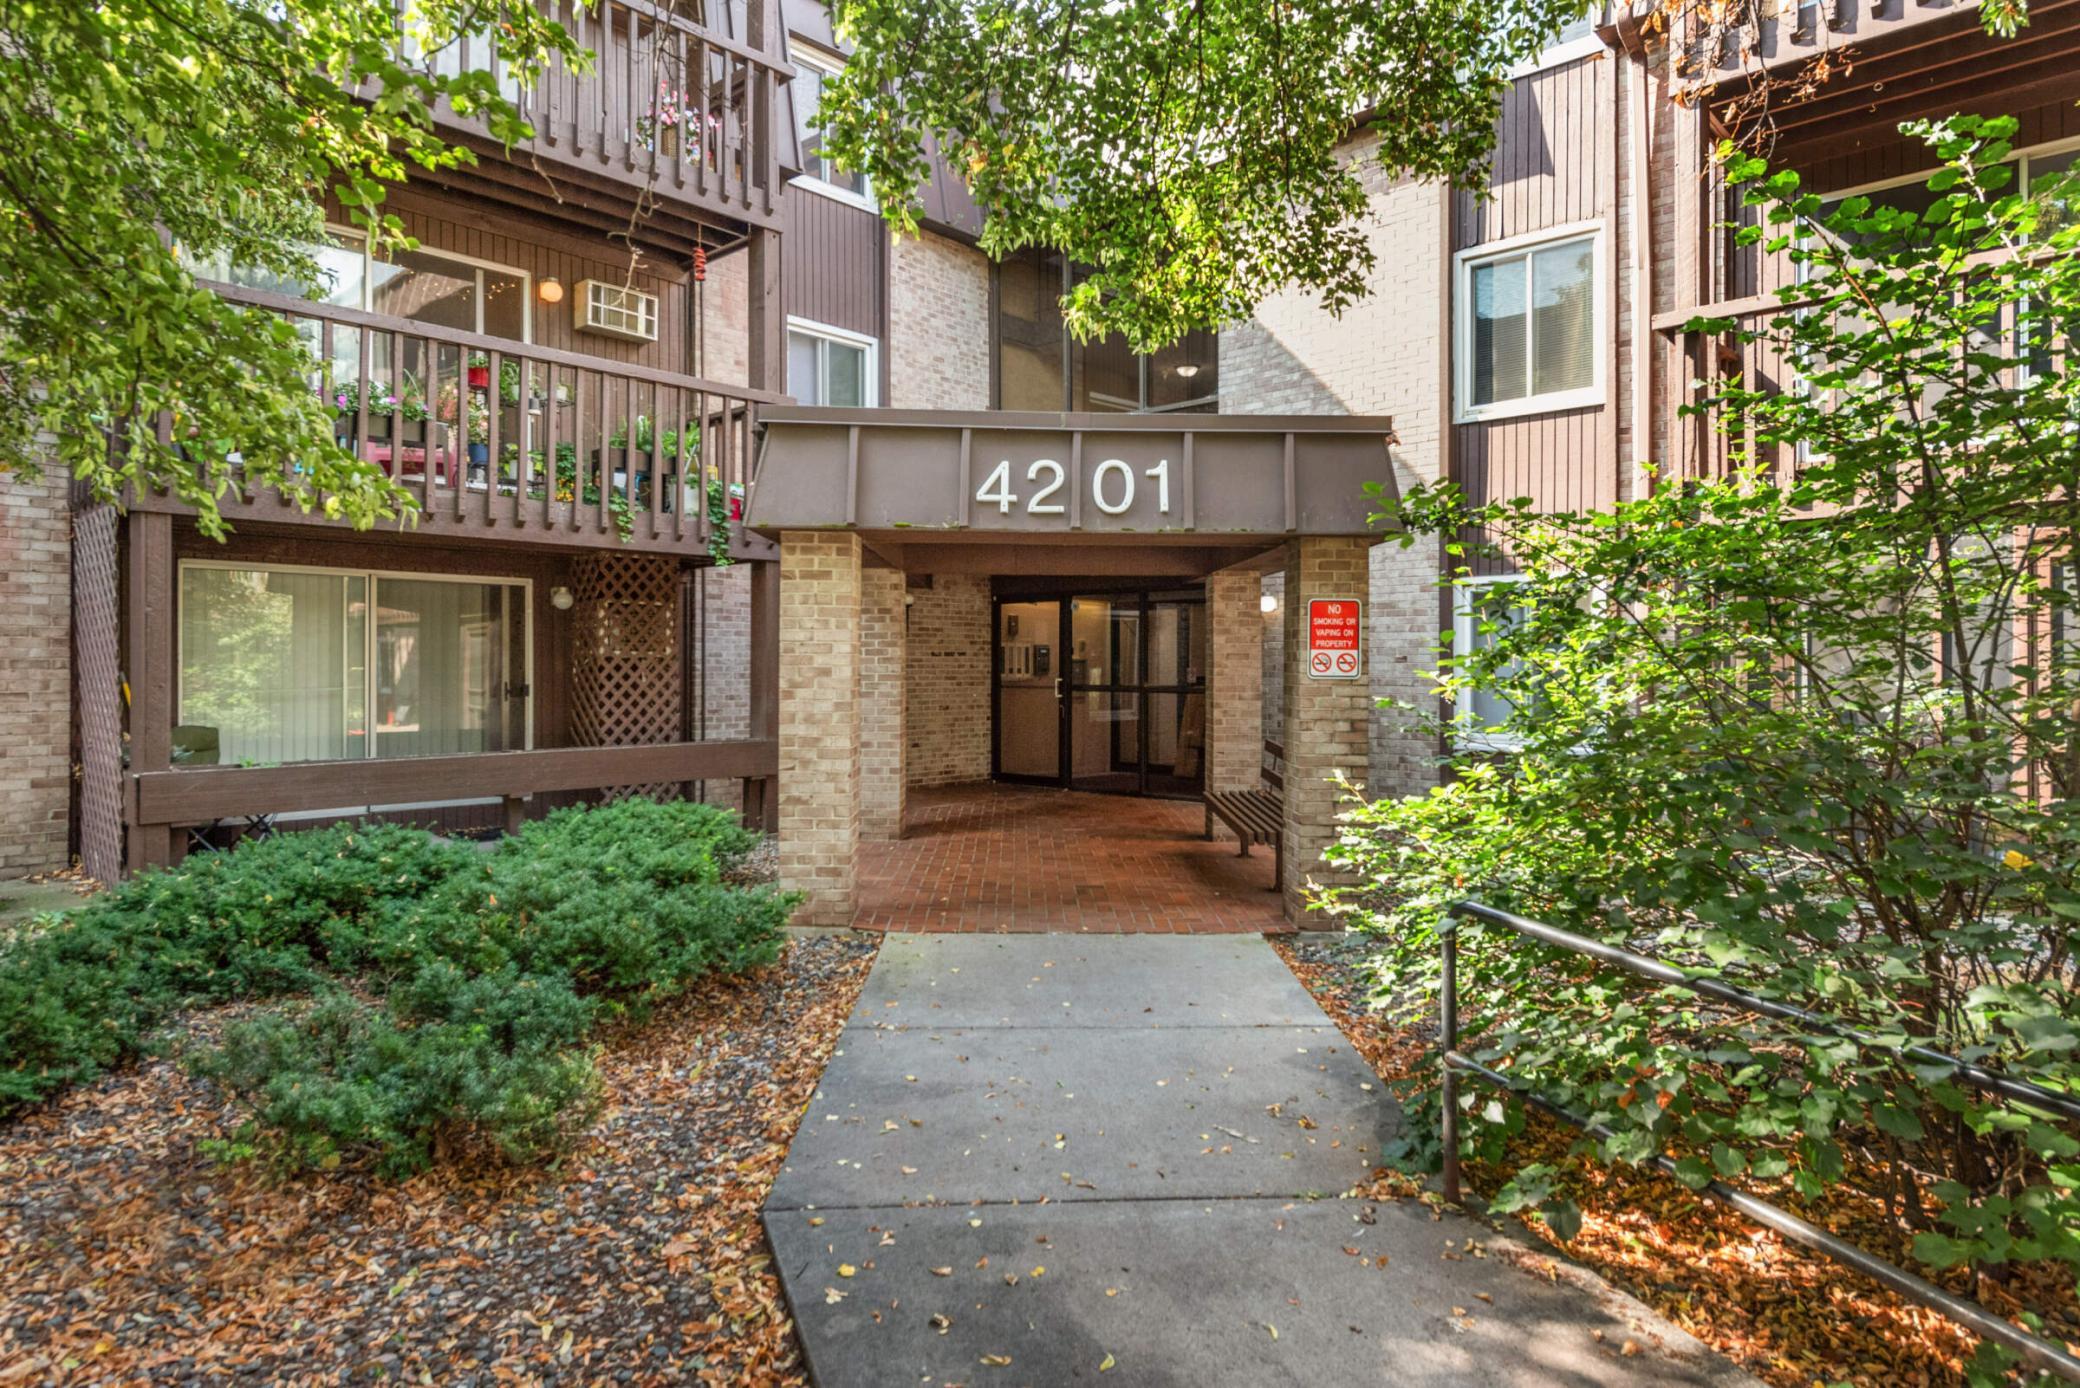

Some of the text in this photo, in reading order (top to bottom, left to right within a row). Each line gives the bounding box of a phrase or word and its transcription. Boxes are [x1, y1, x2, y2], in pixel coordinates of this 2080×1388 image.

[976, 459, 1169, 514] 4201
[1328, 604, 1341, 614] NO
[1313, 617, 1356, 625] SMOKING OR
[1343, 629, 1354, 637] ON
[1316, 640, 1353, 648] PROPERTY
